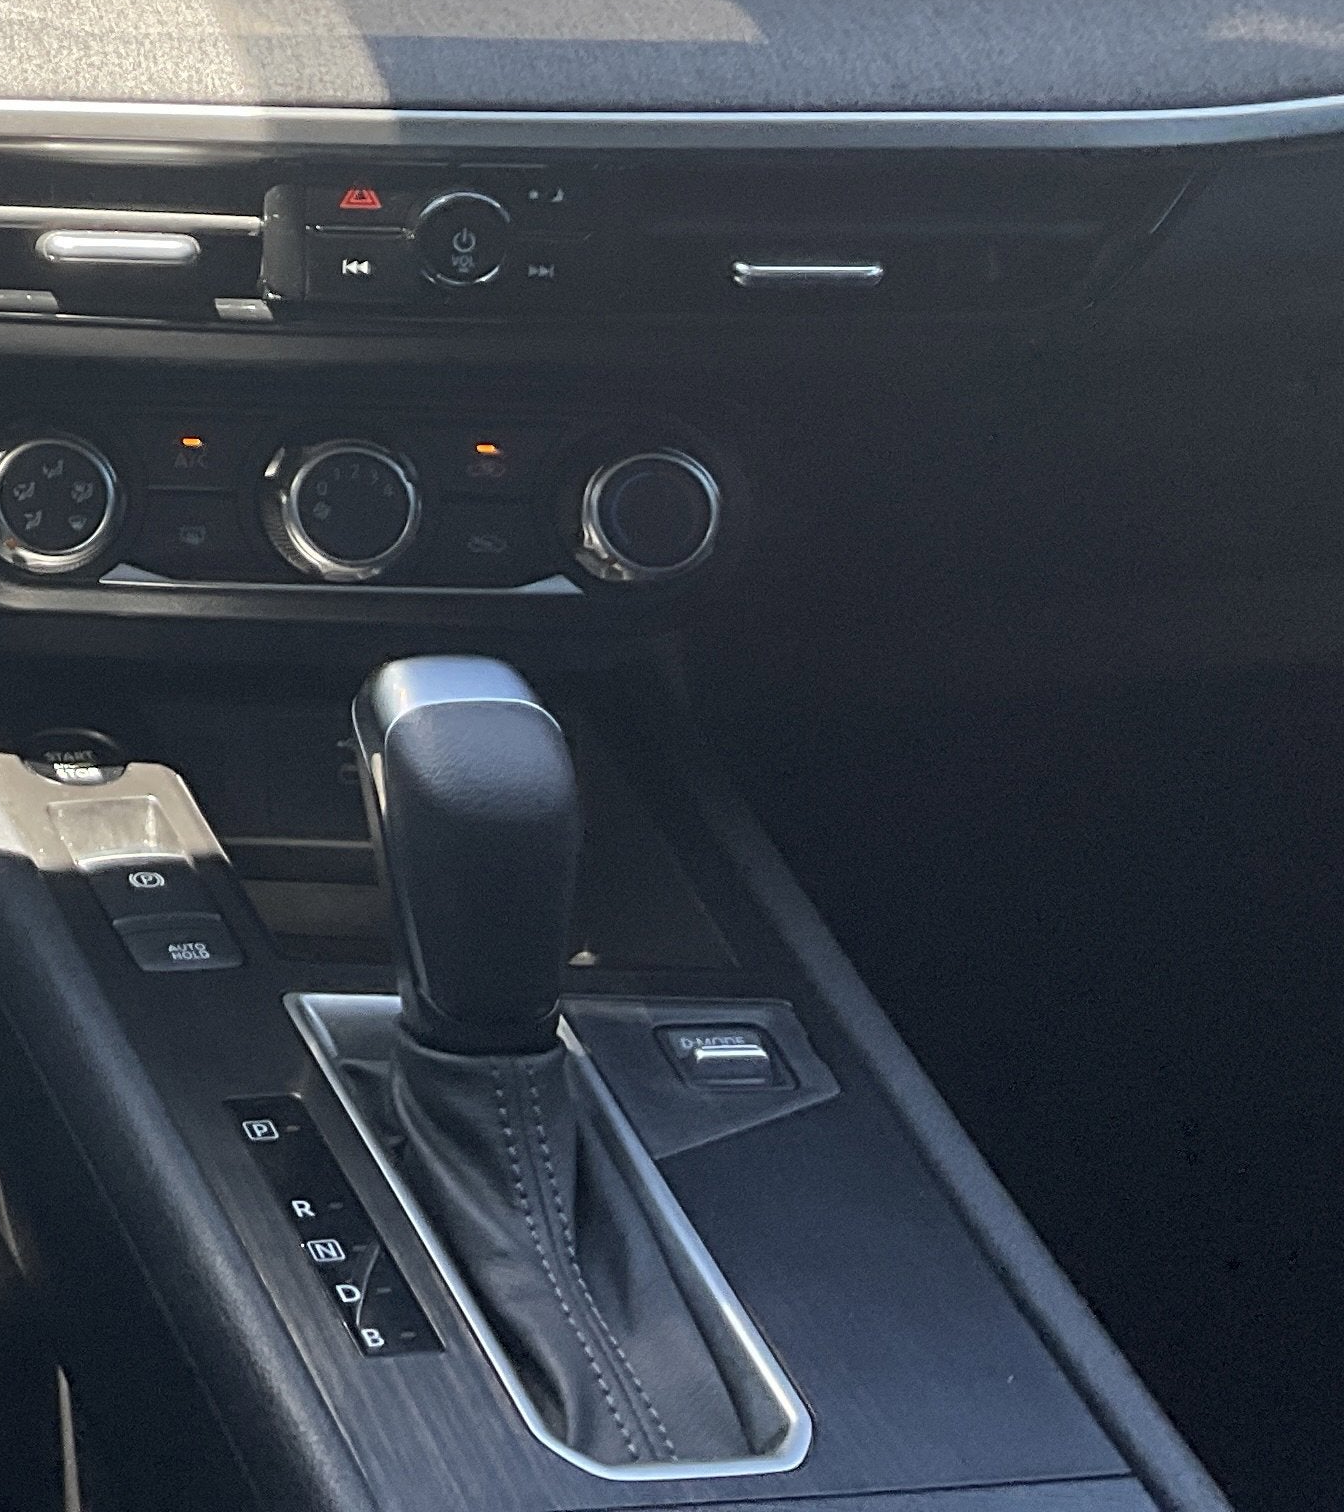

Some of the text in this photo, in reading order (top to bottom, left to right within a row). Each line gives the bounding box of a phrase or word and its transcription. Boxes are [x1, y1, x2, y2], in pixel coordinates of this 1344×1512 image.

[168, 942, 206, 952] AUTO
[291, 1200, 316, 1218] R
[335, 1284, 361, 1303] D
[360, 1328, 385, 1348] B
